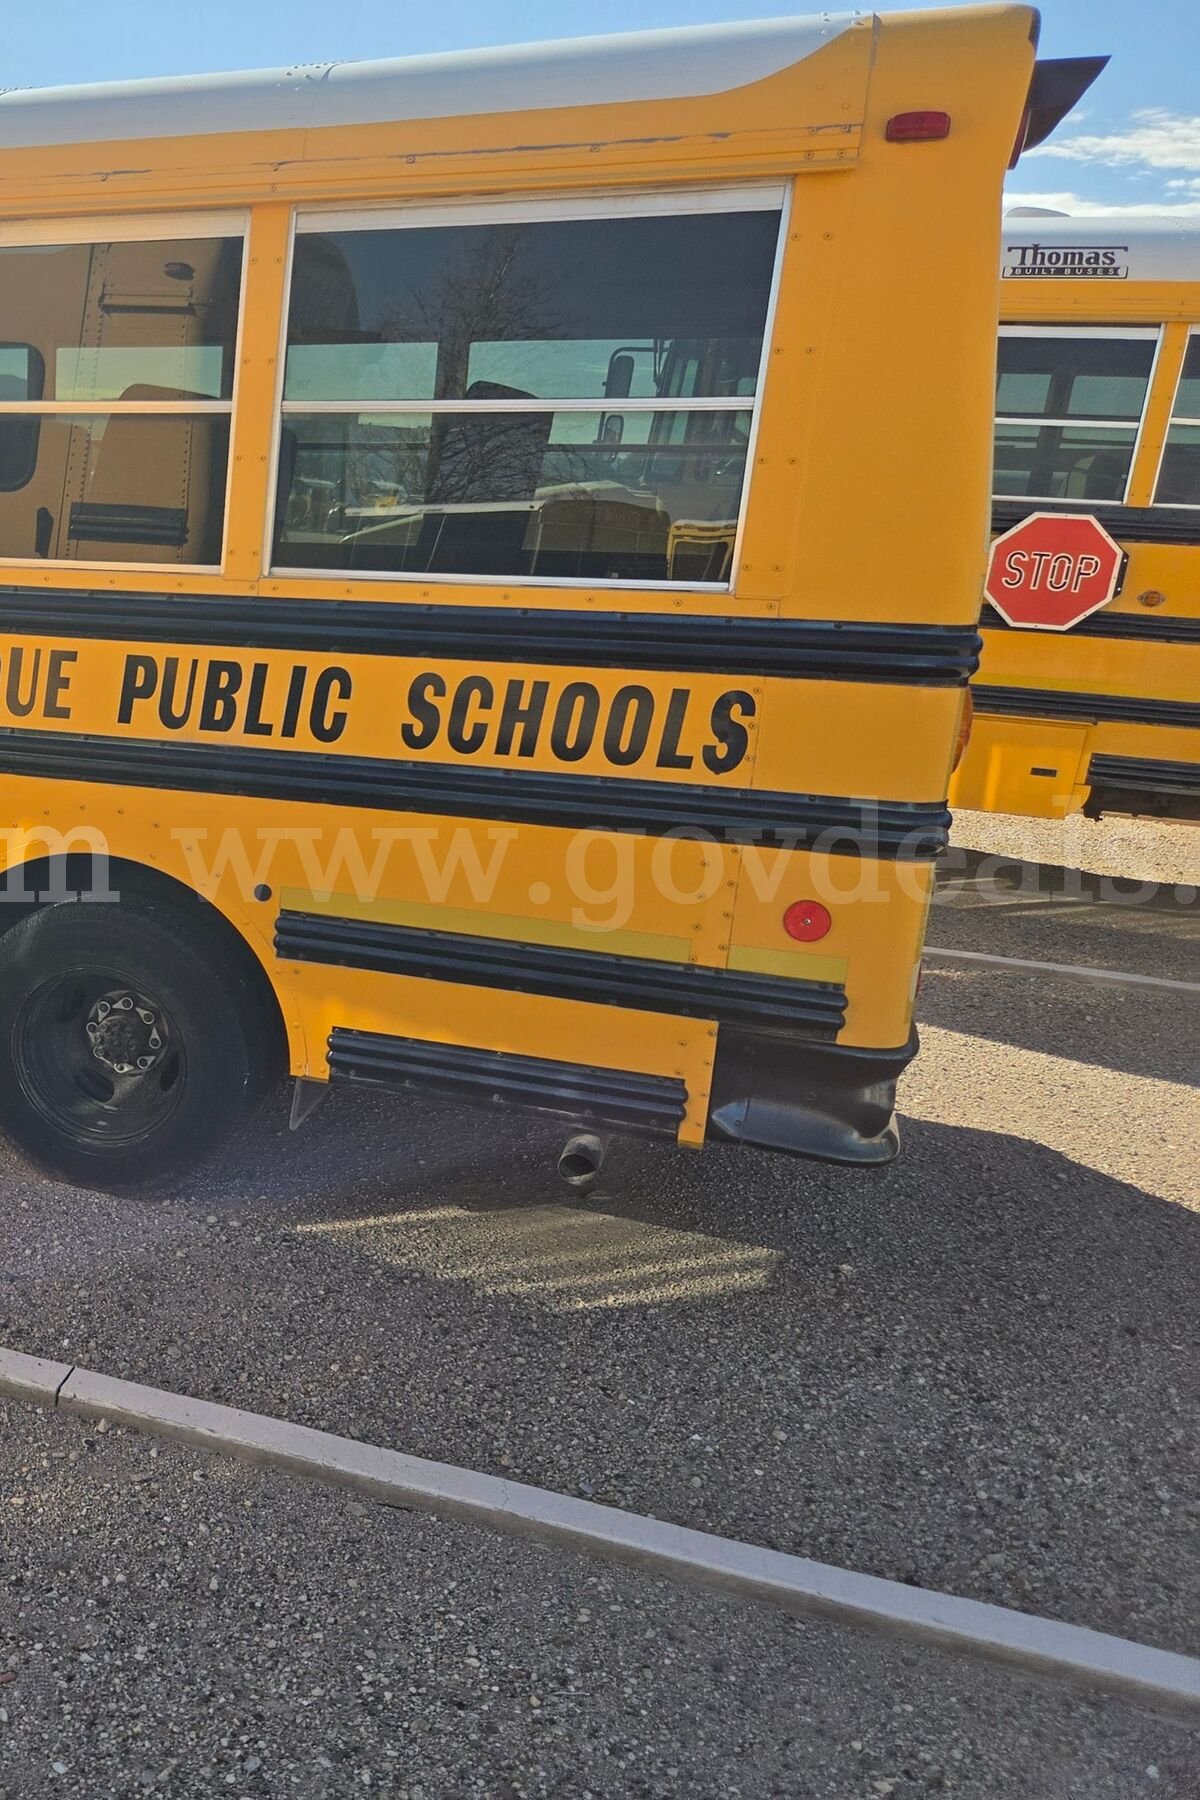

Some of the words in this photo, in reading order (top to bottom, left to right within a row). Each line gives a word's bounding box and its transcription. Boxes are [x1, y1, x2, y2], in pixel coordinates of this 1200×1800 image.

[1008, 244, 1127, 266] Thomas
[1001, 550, 1101, 593] STOP
[117, 654, 352, 743] PUBLIC
[401, 672, 756, 775] SCHOOLS
